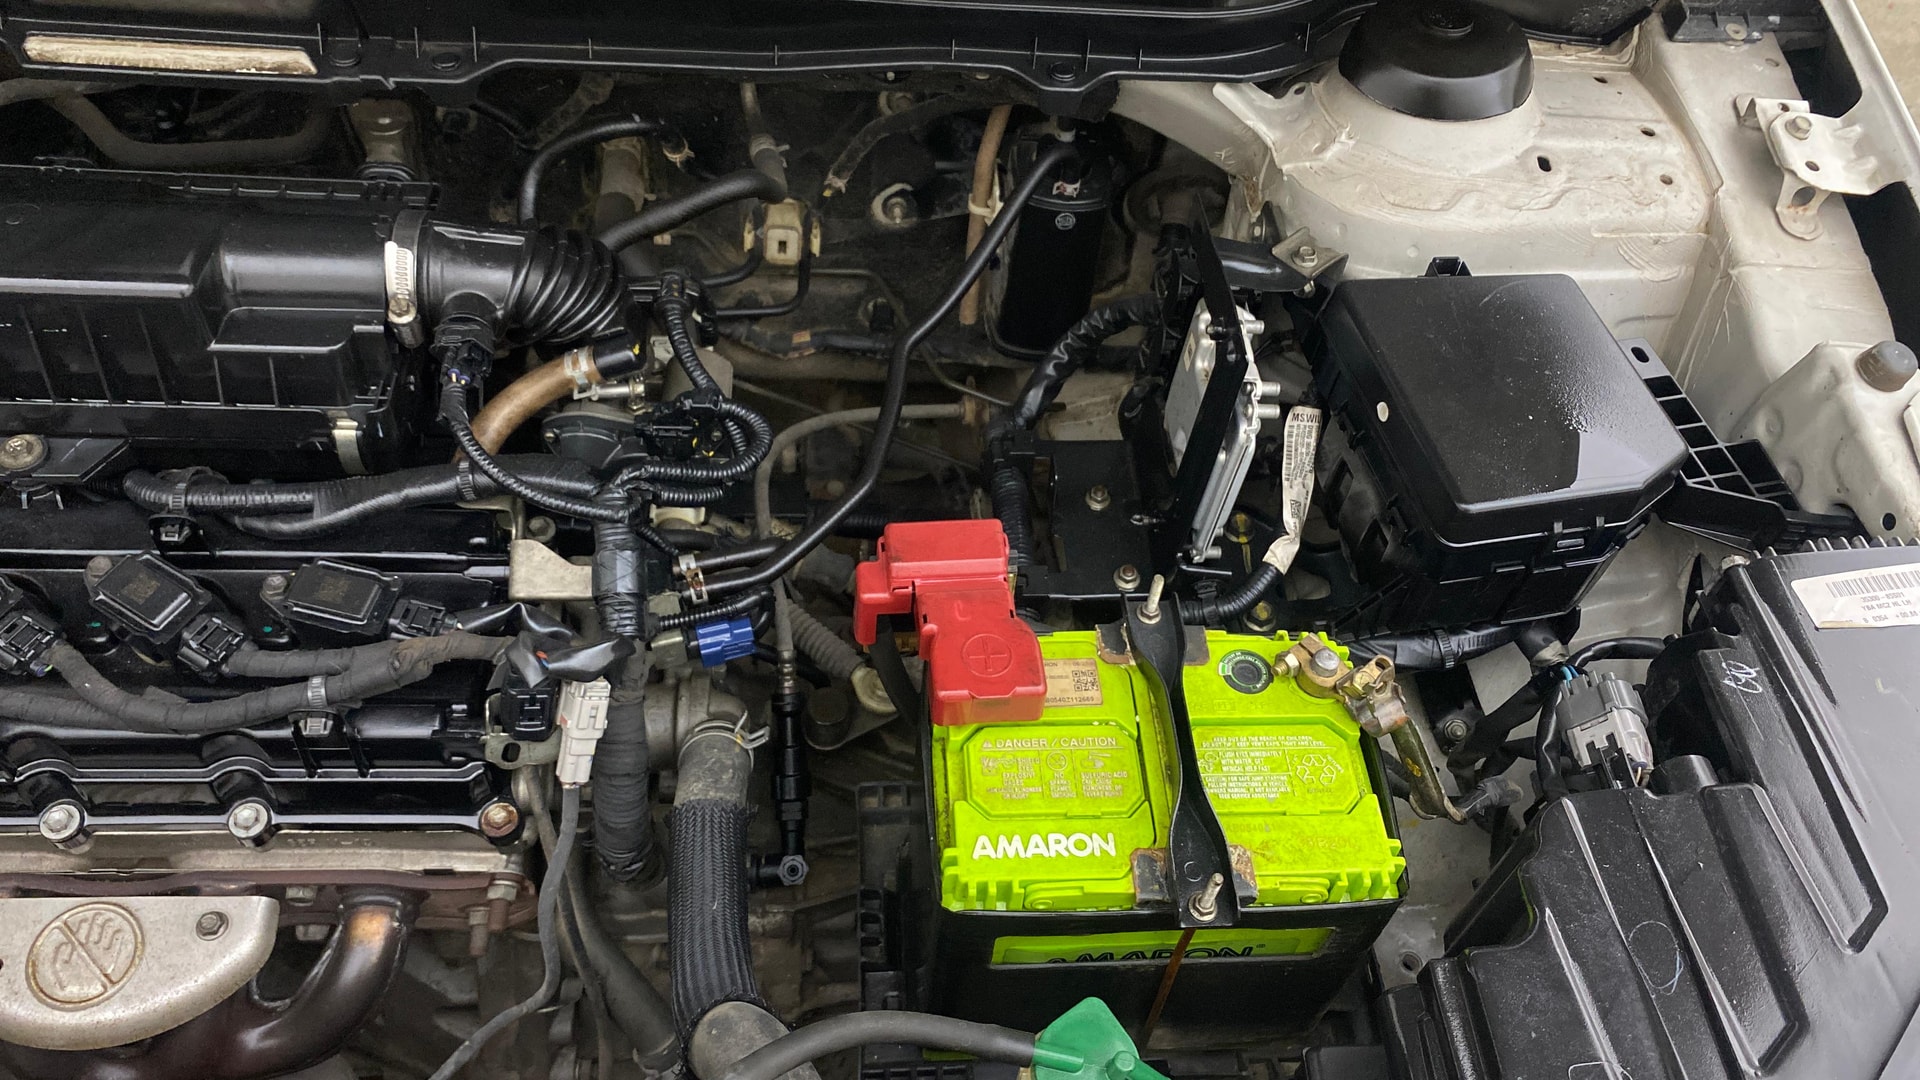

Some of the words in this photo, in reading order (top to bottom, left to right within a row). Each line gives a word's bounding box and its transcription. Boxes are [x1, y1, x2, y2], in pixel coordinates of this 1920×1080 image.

[996, 738, 1048, 748] DANGER
[1060, 737, 1116, 747] CAUTION
[972, 832, 1116, 860] AMARON
